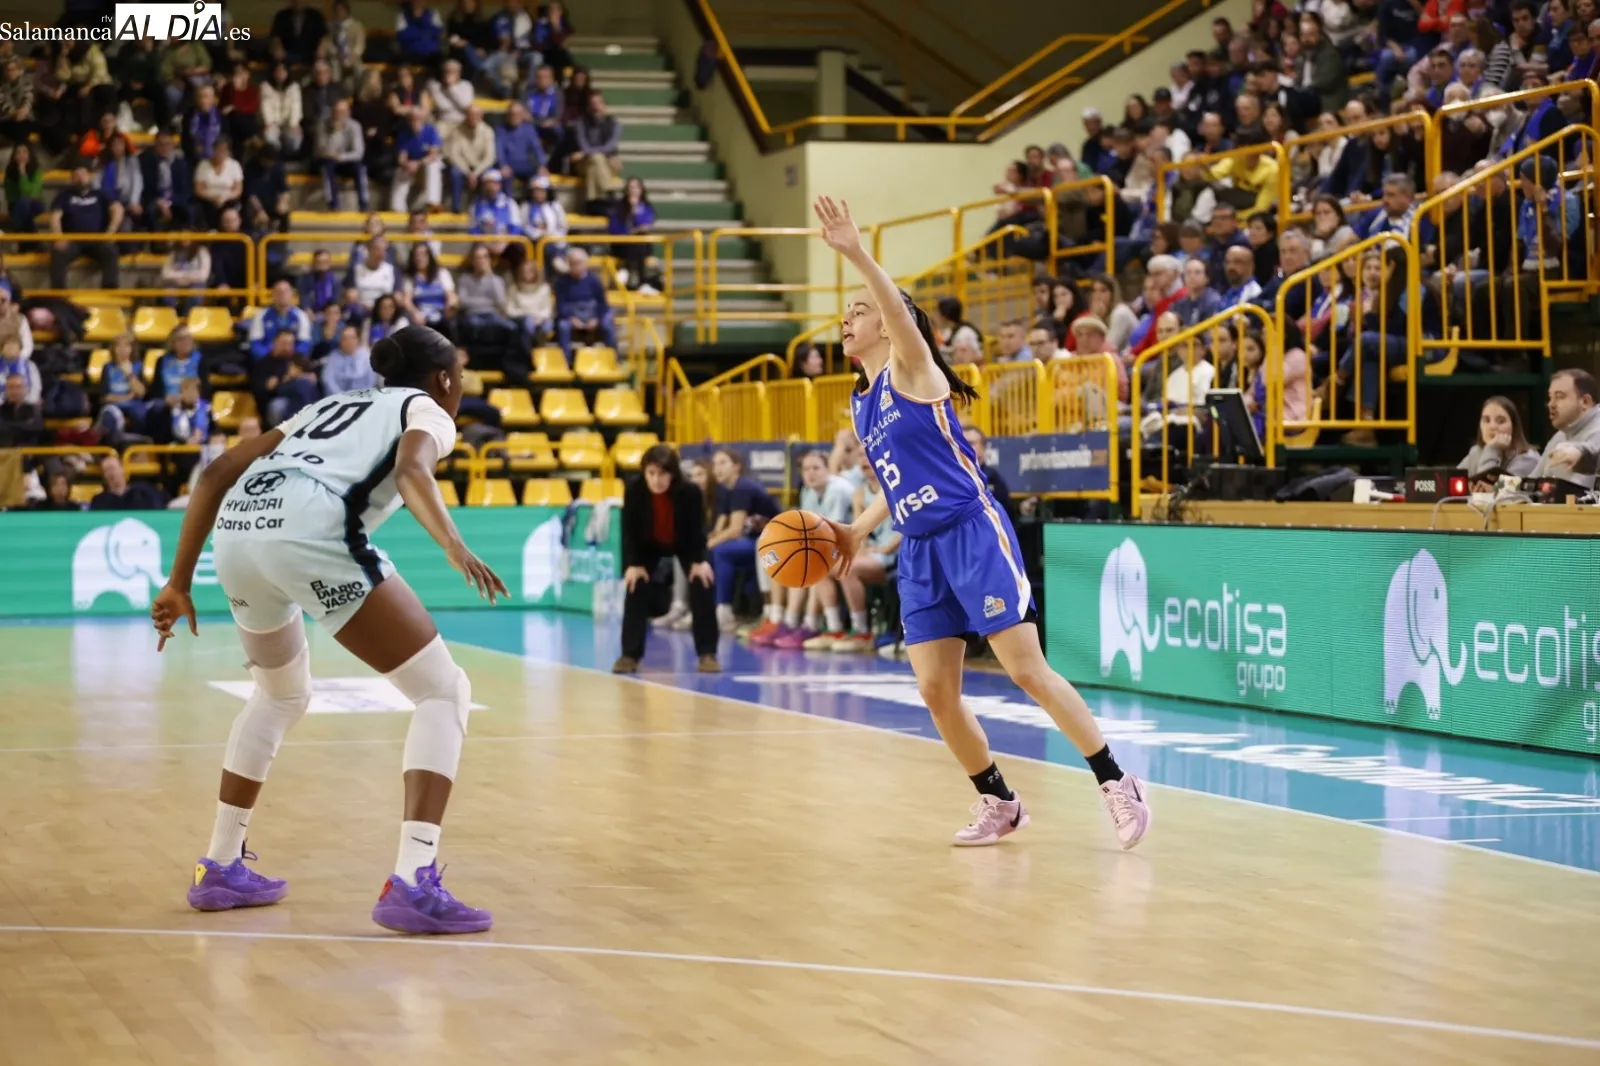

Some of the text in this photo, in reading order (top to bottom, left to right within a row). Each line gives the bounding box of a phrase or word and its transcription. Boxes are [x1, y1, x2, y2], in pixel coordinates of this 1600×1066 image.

[292, 400, 374, 440] 10
[223, 497, 283, 513] HYUNDAI
[255, 516, 285, 530] Car
[310, 580, 328, 591] EL
[316, 581, 363, 600] DIARIO
[321, 591, 365, 609] VASCO
[1164, 582, 1287, 656] ecotisa
[1237, 661, 1286, 698] grupo
